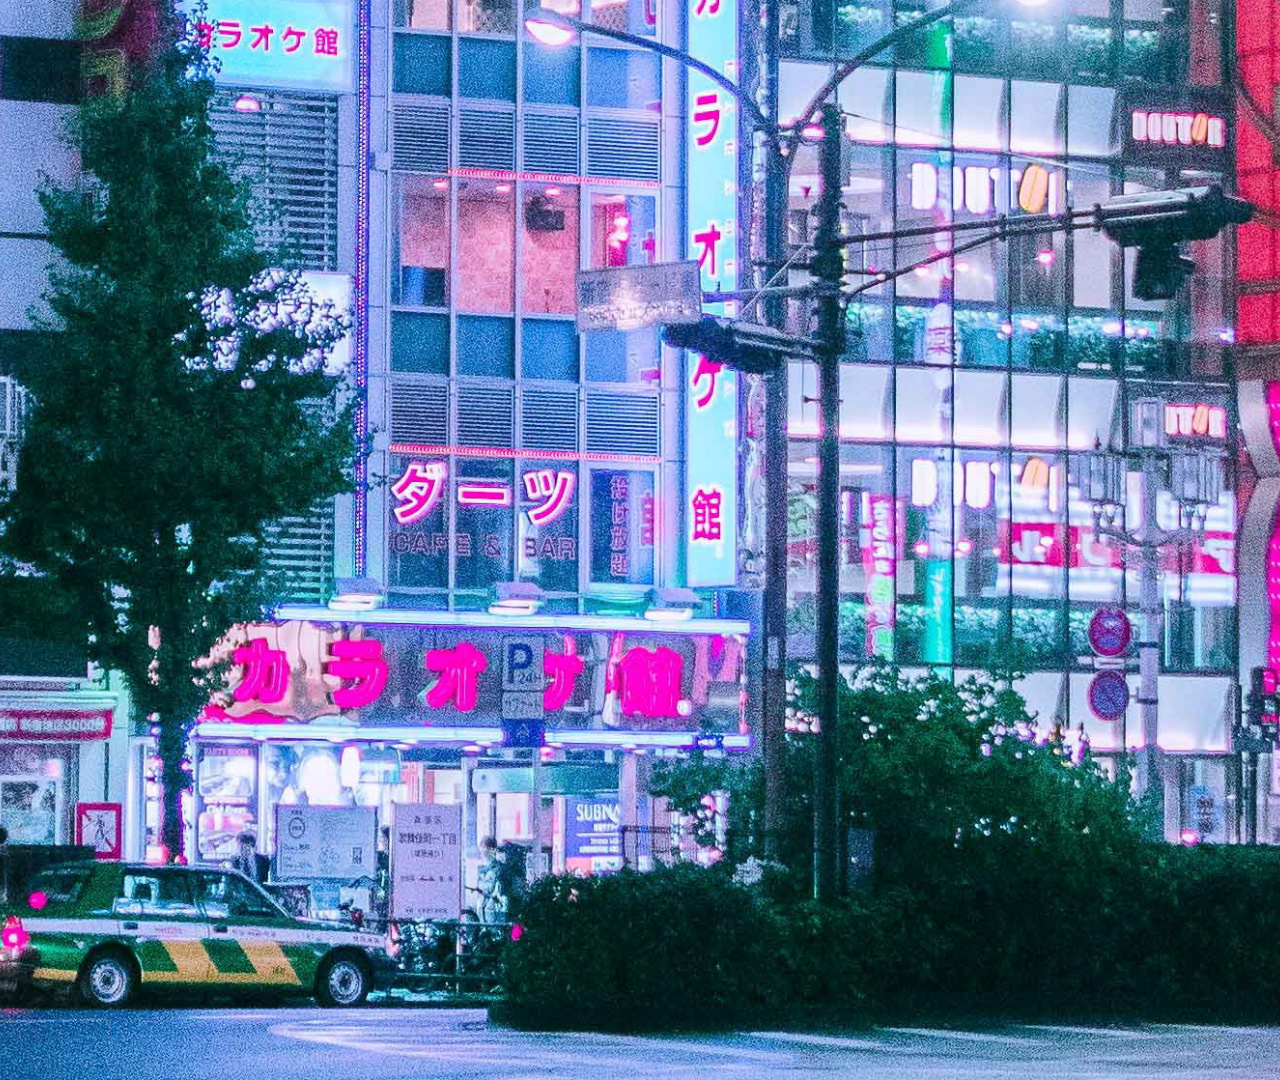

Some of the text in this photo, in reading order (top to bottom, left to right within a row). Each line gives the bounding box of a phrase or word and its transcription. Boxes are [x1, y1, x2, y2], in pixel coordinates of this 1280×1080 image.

[392, 460, 577, 526] ダーツ
[392, 531, 472, 557] CAFE
[523, 537, 576, 560] BAR
[508, 643, 533, 684] P
